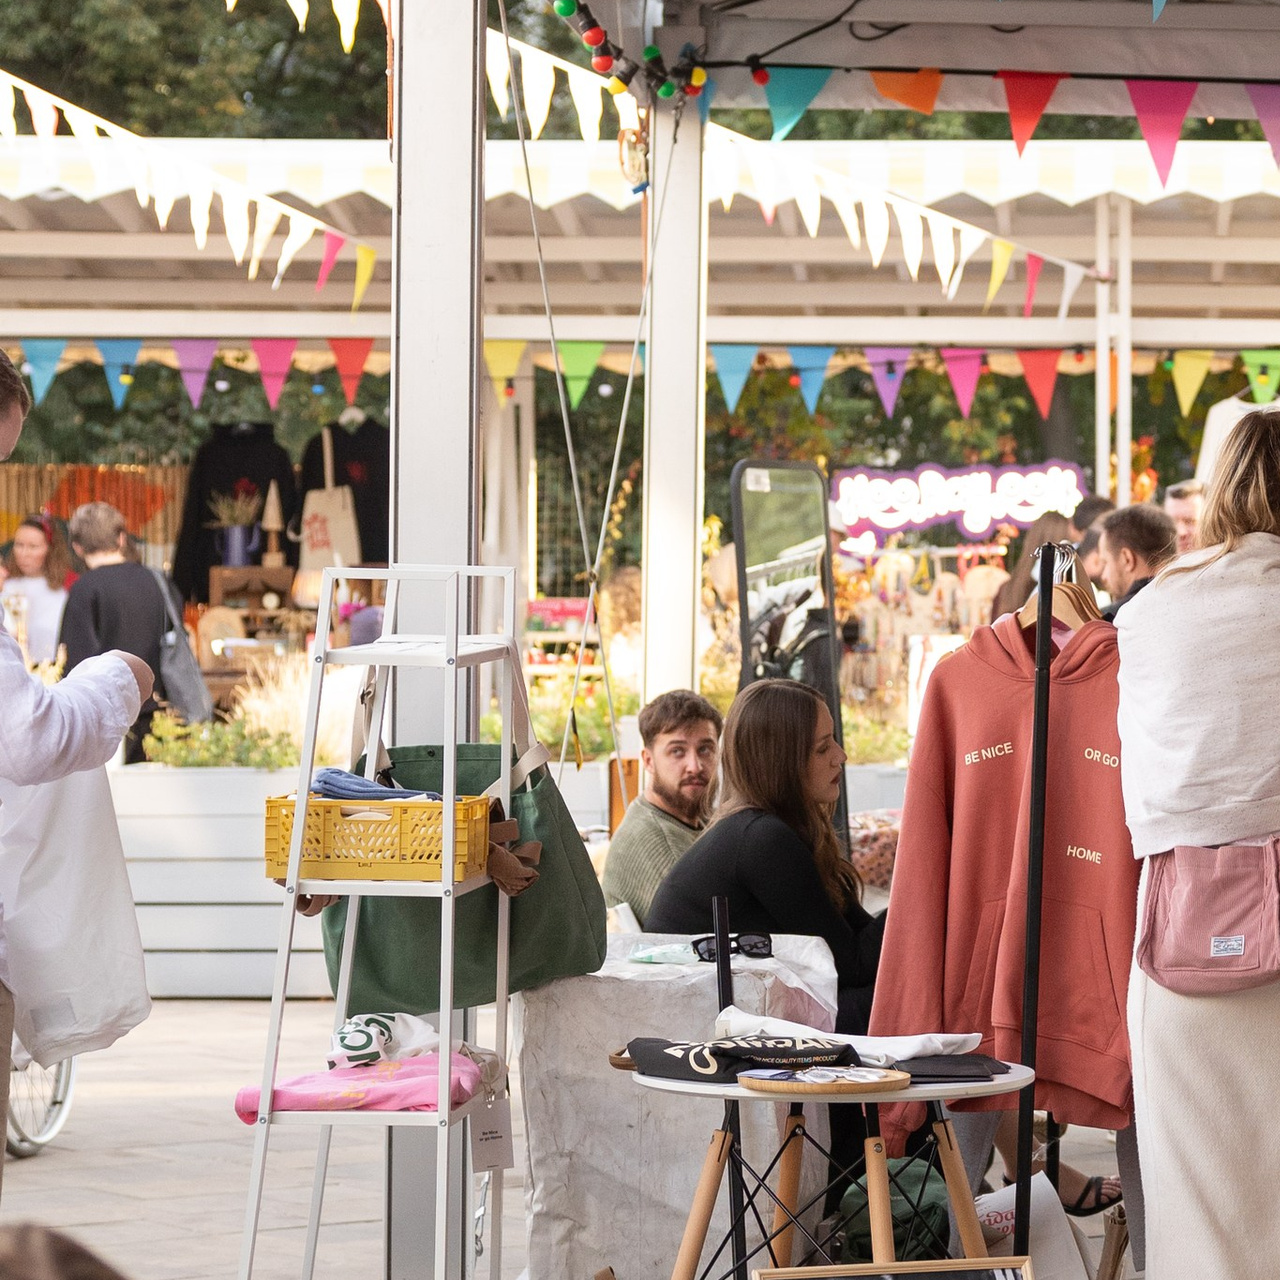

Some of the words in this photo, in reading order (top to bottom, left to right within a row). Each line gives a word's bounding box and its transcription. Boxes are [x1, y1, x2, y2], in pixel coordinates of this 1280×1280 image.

[964, 749, 981, 766] BE
[981, 741, 1014, 760] NICE
[1084, 747, 1102, 763] OR
[1102, 751, 1119, 768] GO
[1066, 845, 1102, 864] HOME
